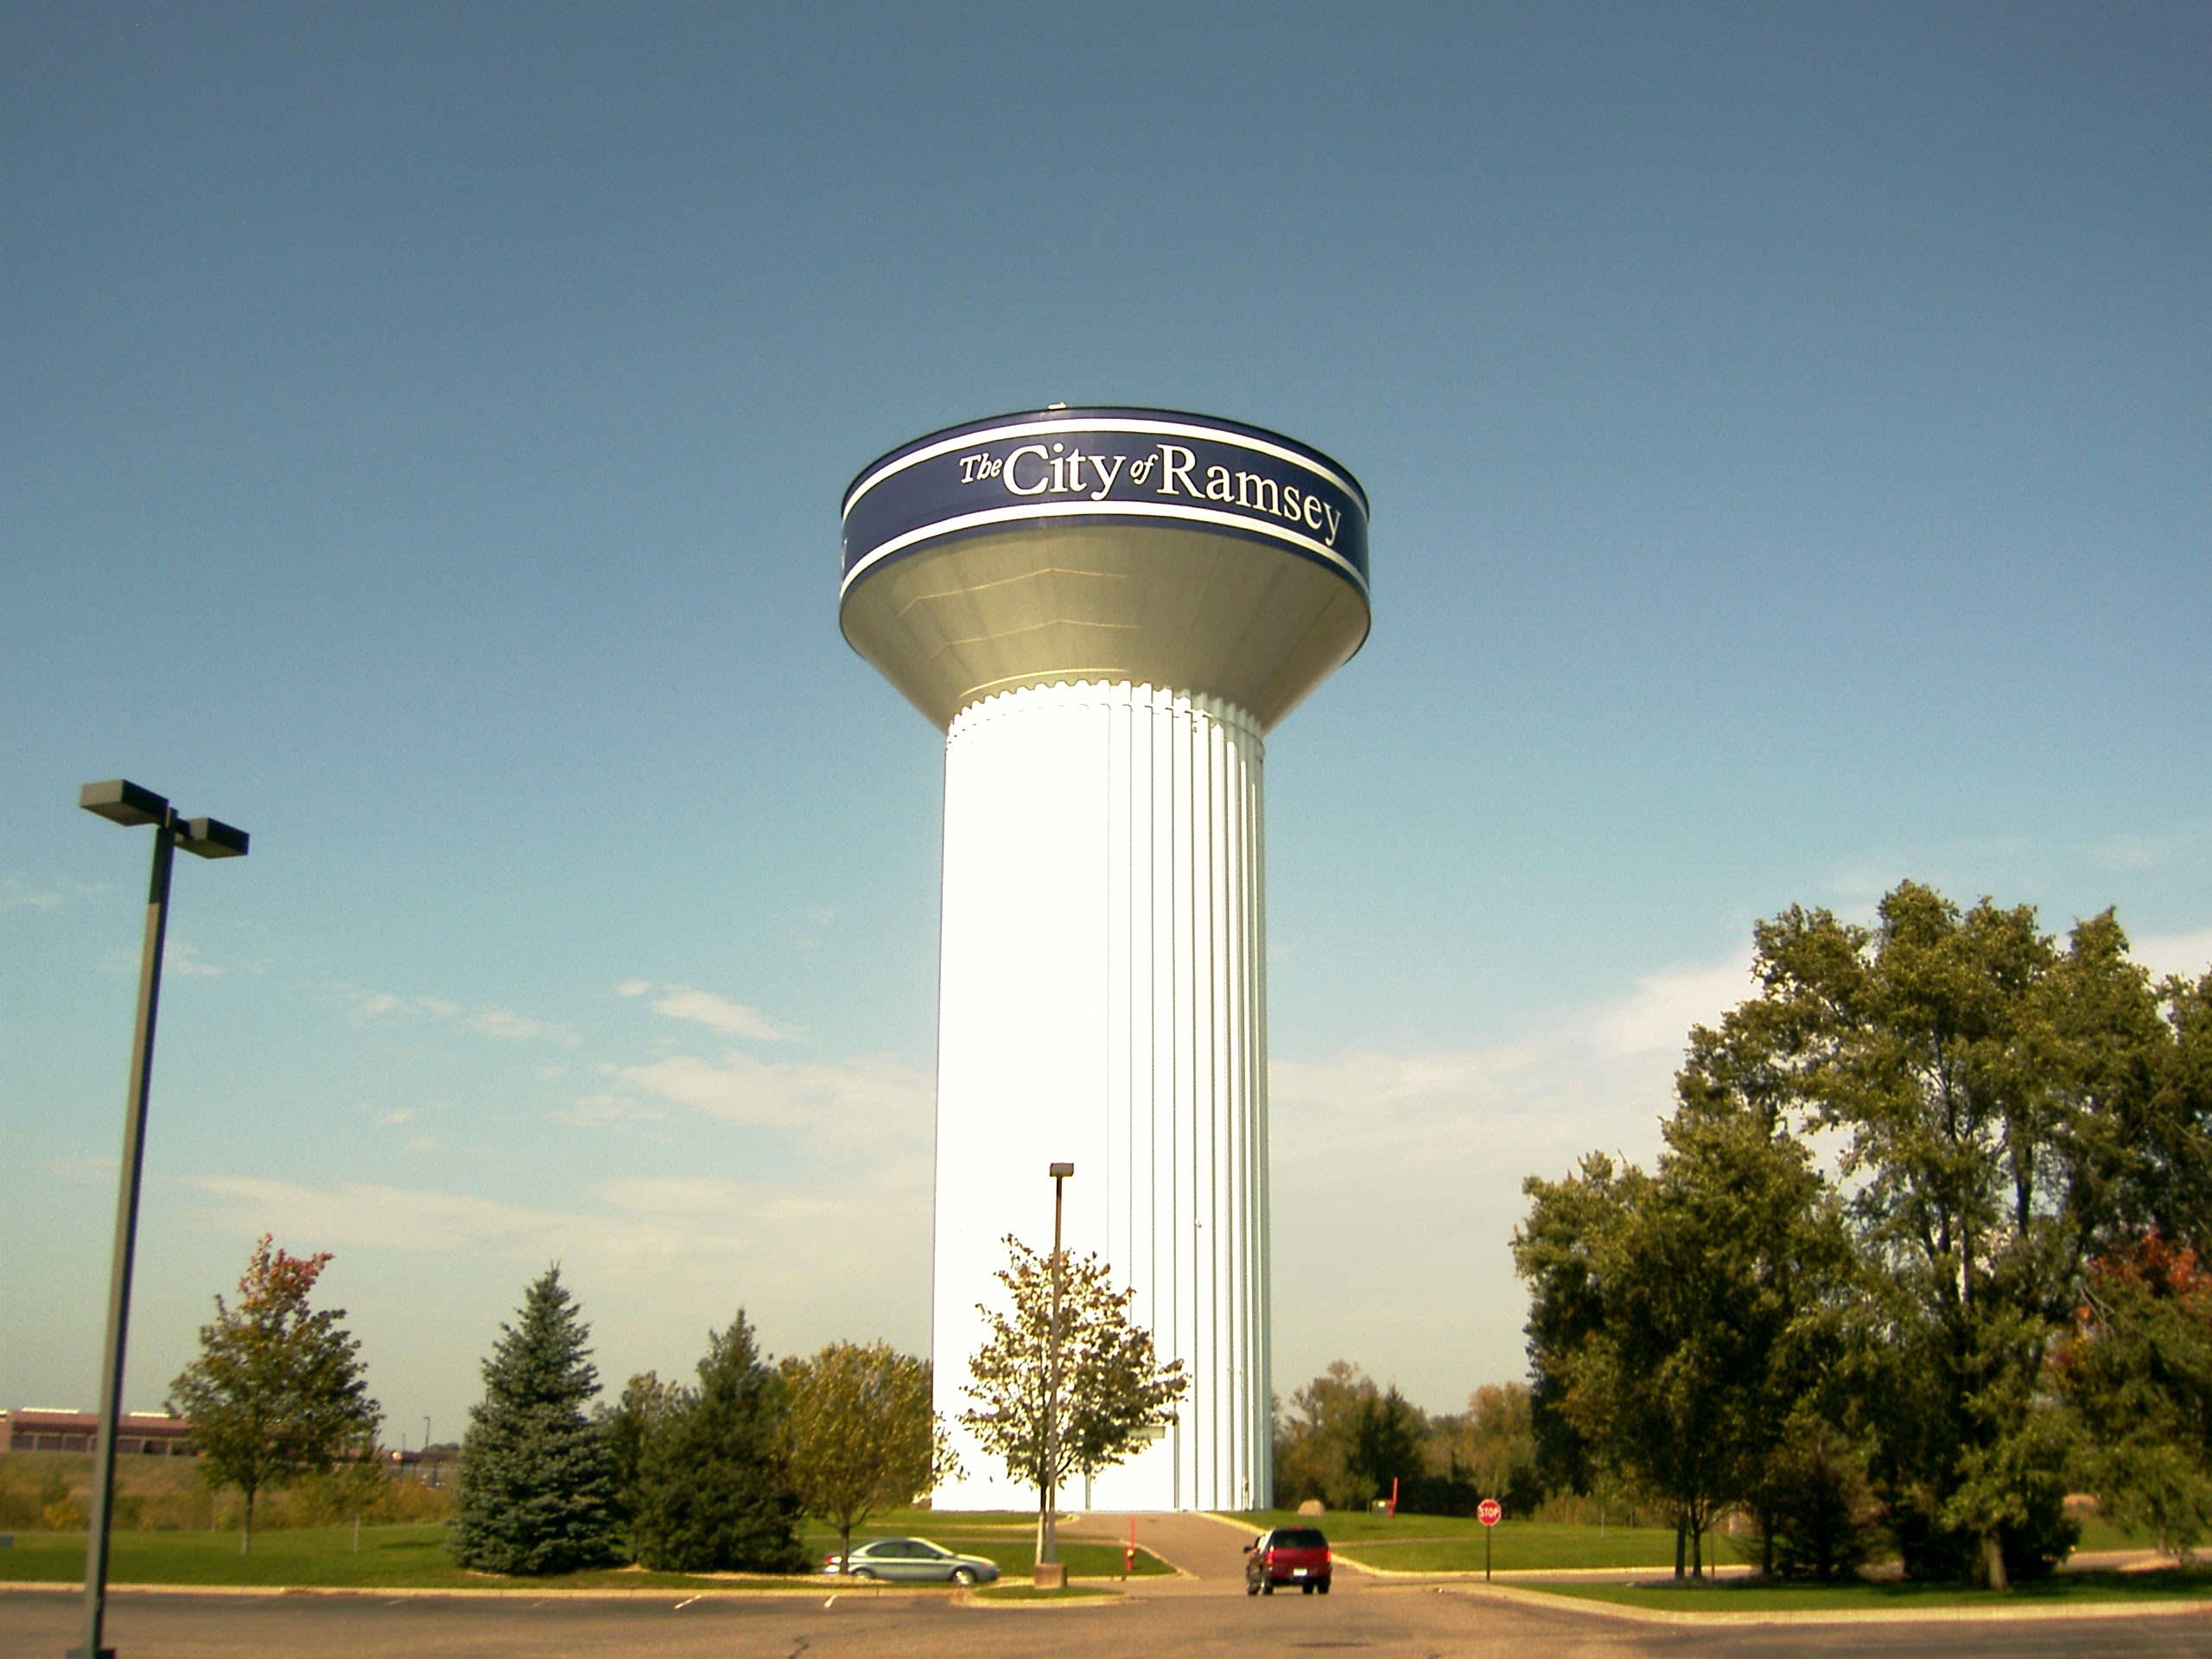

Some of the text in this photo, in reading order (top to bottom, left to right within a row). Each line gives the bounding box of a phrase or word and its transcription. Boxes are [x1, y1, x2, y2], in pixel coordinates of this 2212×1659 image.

[959, 442, 1341, 546] The City of Ramsey
[1478, 1507, 1499, 1518] STOP
